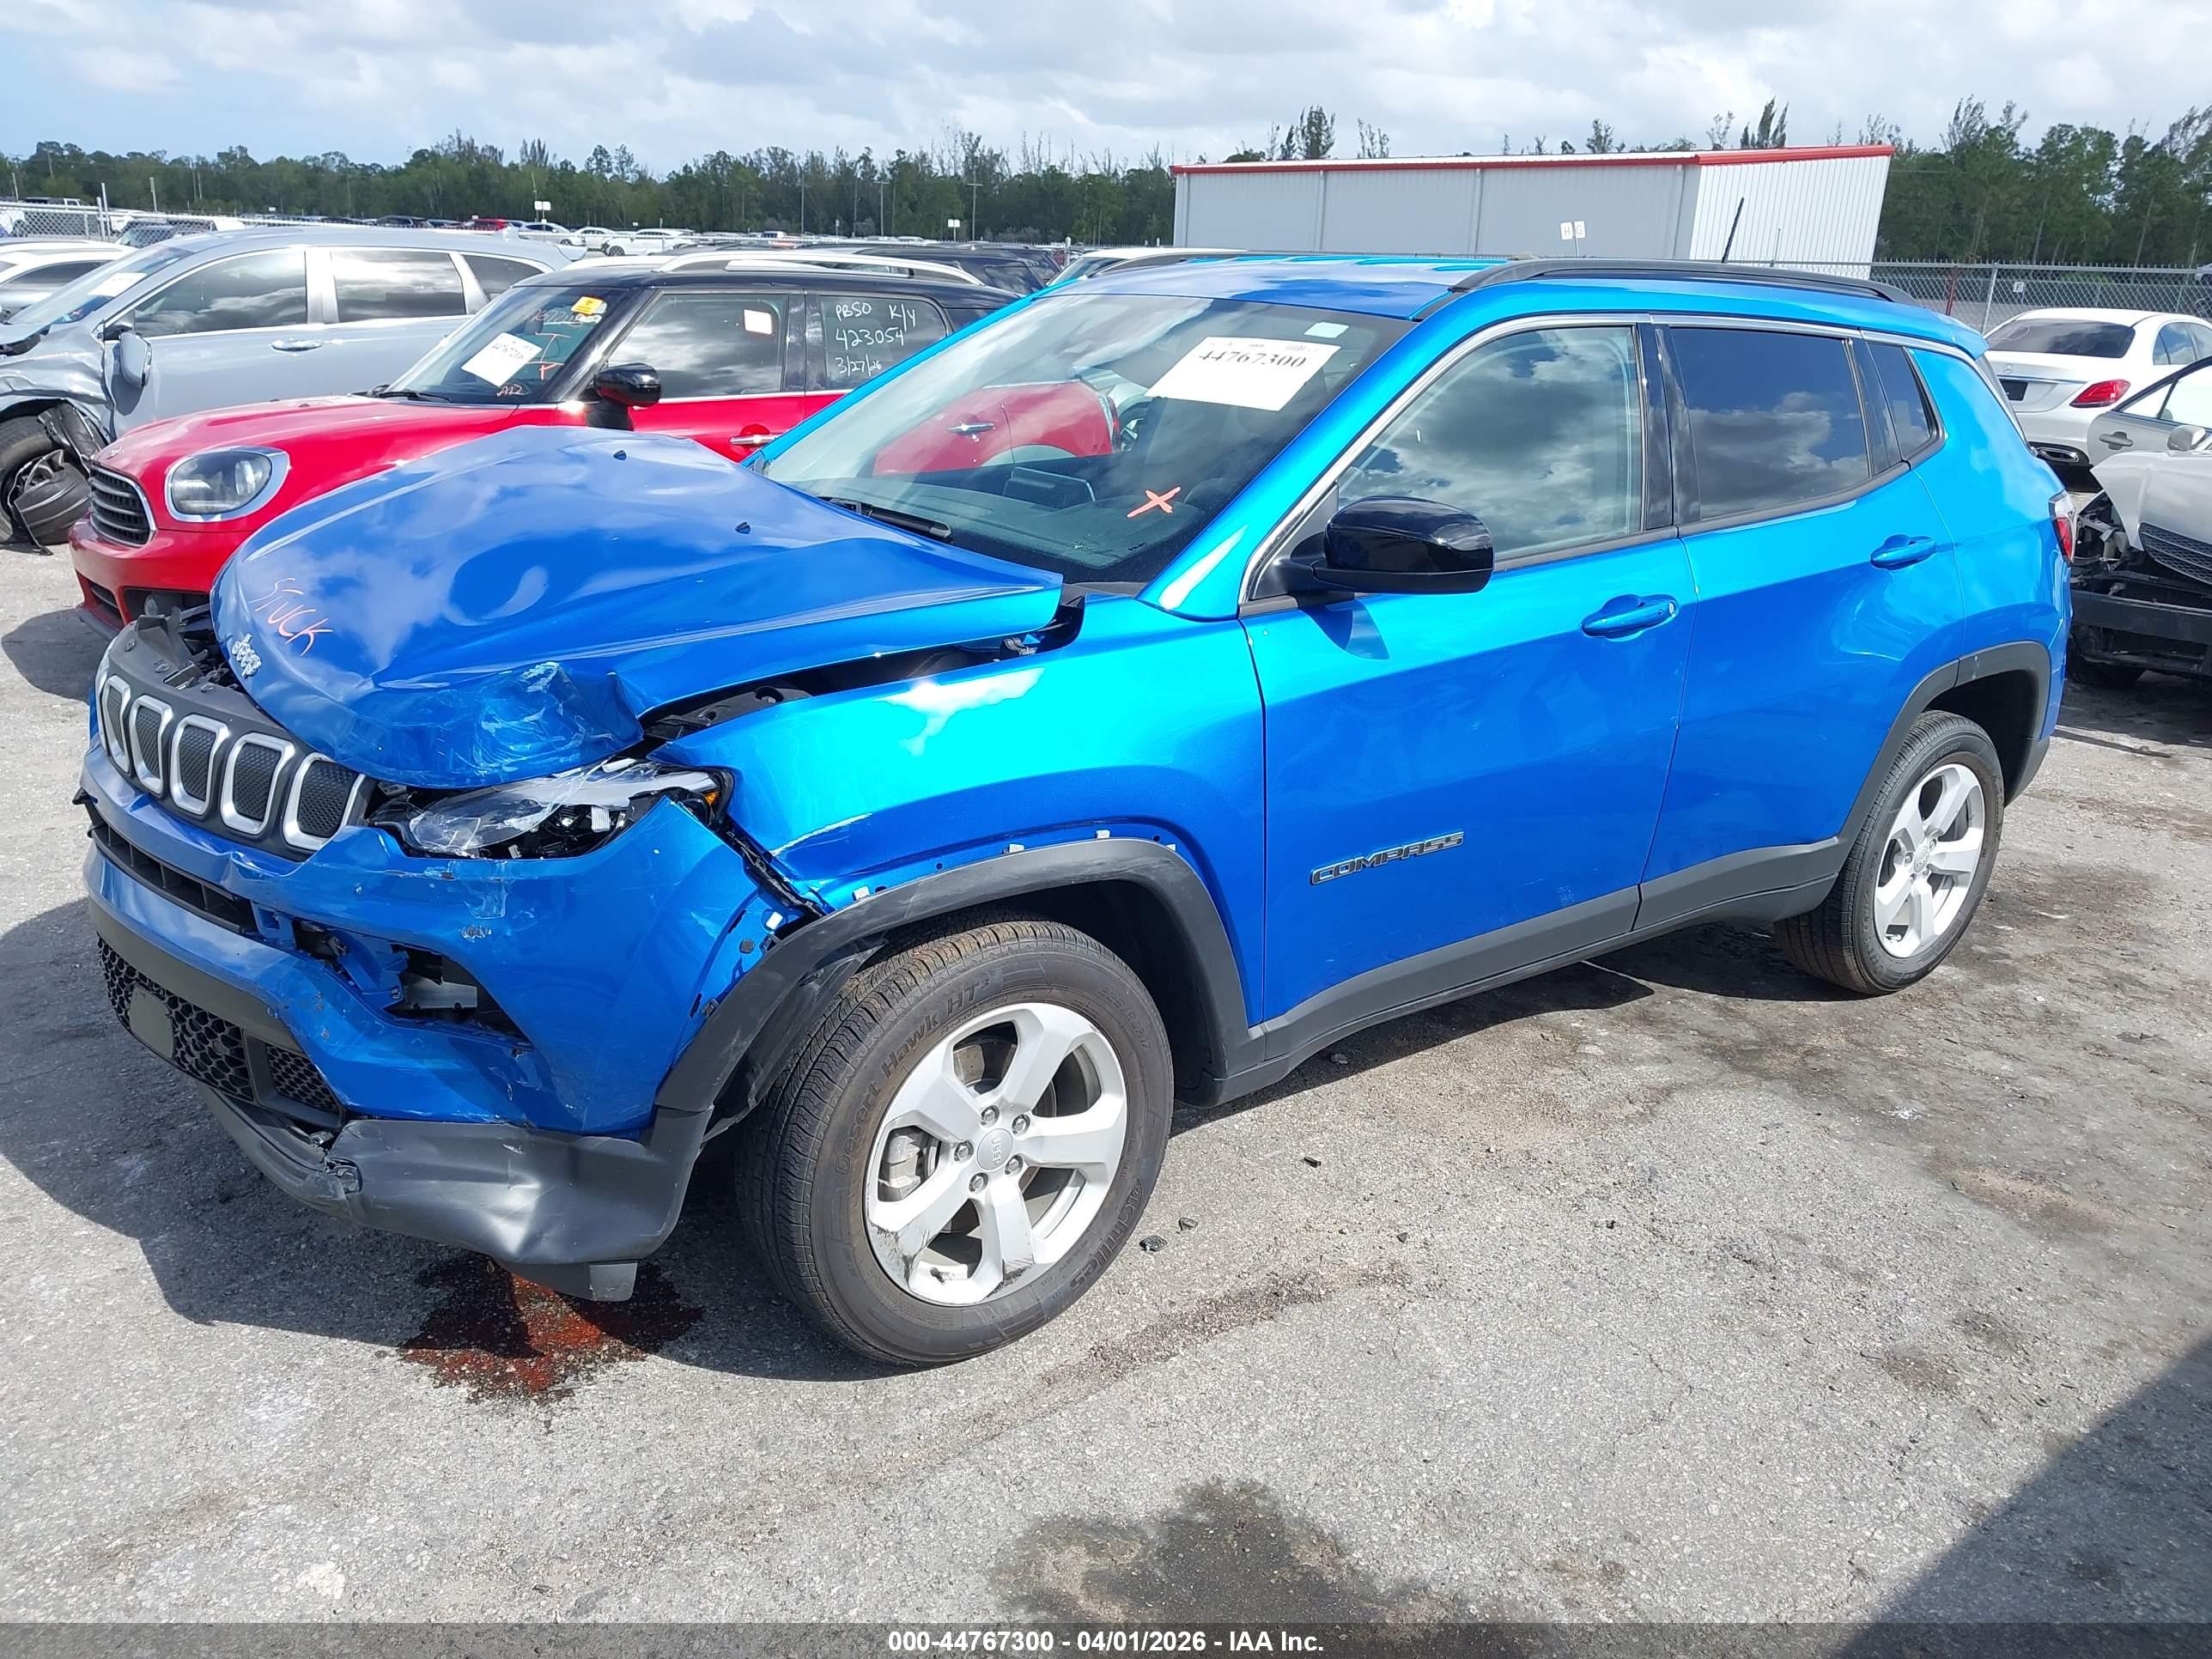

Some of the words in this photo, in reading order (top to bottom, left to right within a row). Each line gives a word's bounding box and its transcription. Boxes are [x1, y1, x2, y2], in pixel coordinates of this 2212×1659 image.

[836, 326, 904, 350] 423054
[835, 354, 882, 377] 3/27/26
[1199, 350, 1307, 368] 44767300
[1310, 830, 1464, 884] COMPASS
[881, 1012, 939, 1079] Hawk
